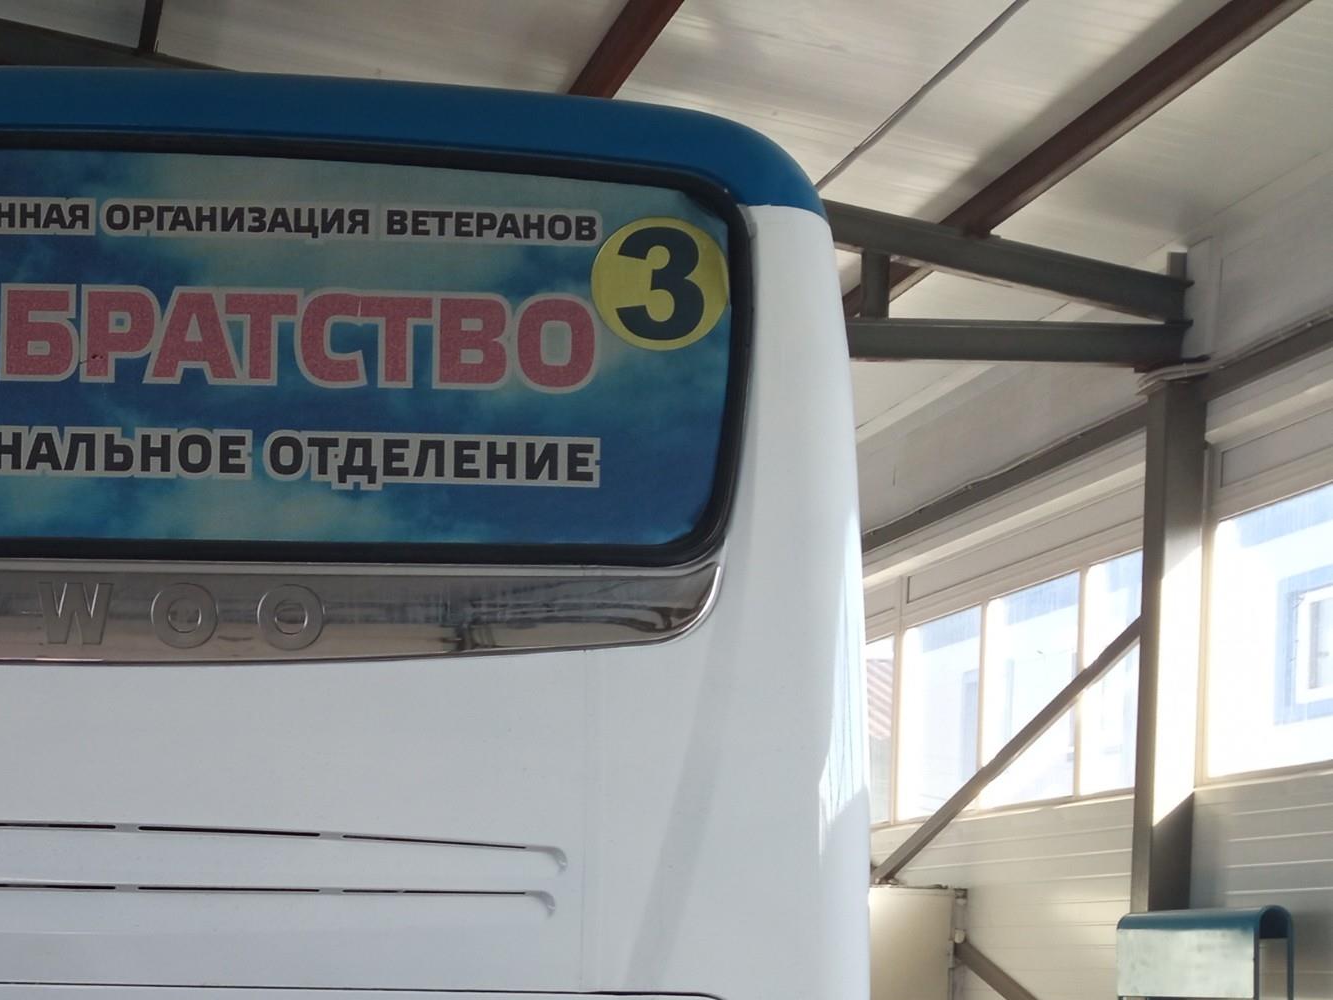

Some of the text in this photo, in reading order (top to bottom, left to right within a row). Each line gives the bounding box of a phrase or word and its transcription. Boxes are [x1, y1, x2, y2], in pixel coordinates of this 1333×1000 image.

[104, 203, 368, 238] ОРГАНИЗАЦИЯ
[386, 210, 597, 241] ВЕТЕРАНОВ
[616, 226, 705, 342] 3
[1, 288, 597, 390] БРАТСТВО
[269, 436, 596, 485] ОТДЕЛЕНИЕ
